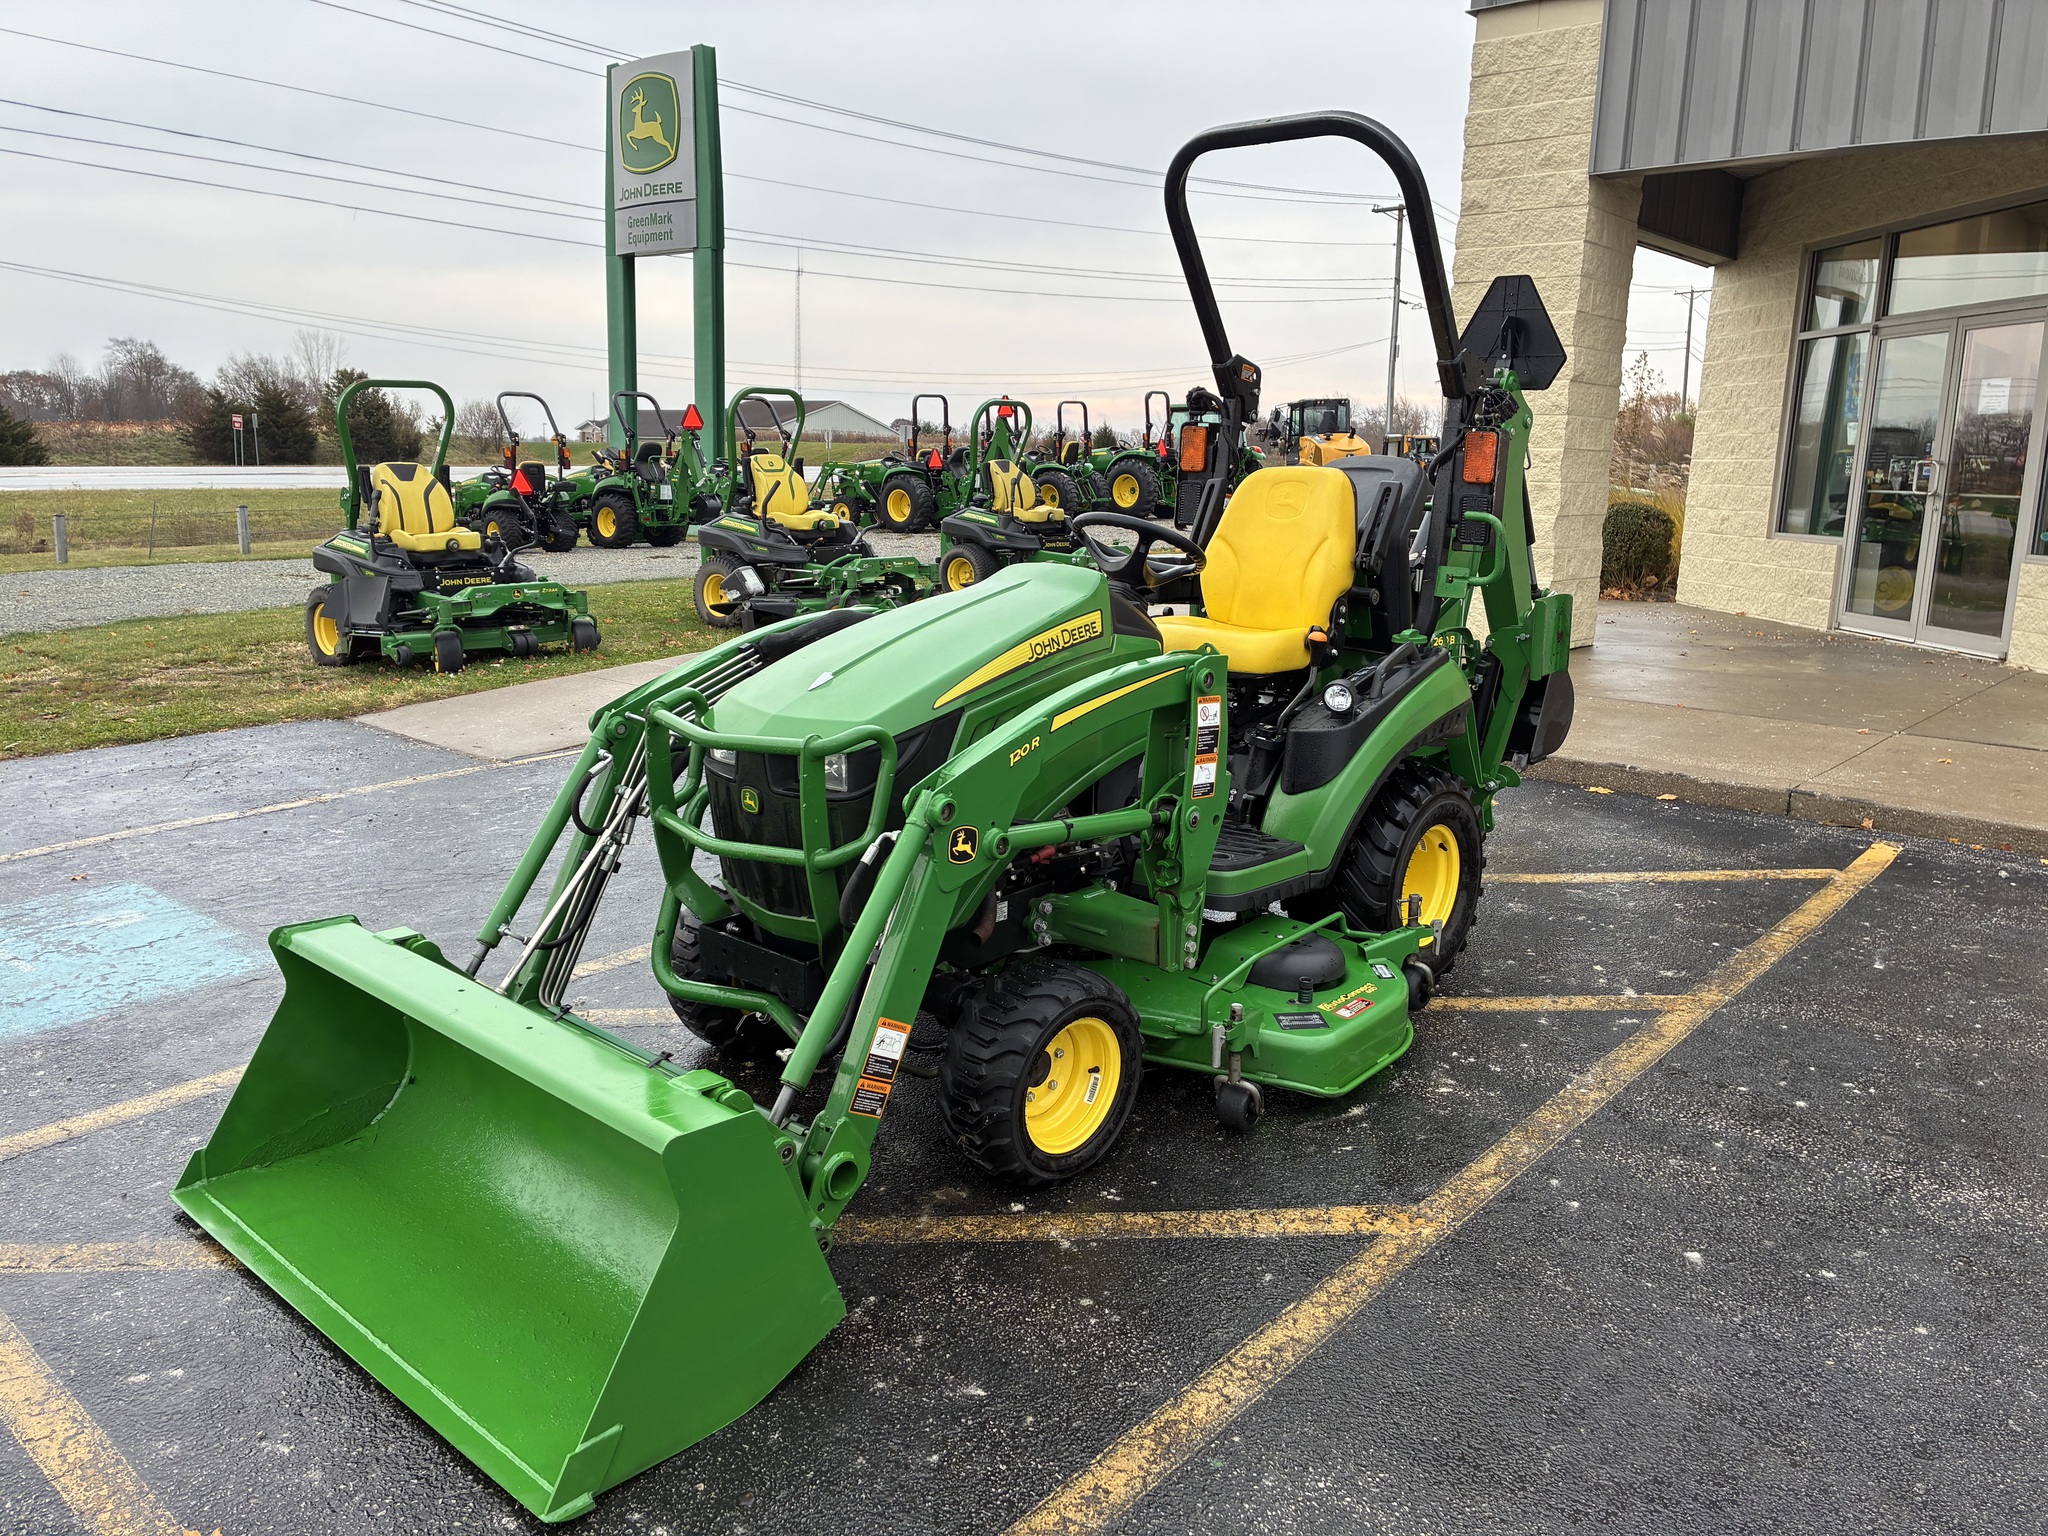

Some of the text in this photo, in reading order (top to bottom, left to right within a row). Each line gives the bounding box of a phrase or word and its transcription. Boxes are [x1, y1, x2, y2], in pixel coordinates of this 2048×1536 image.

[619, 181, 683, 202] JOHN DEERE
[627, 211, 673, 229] GreenMark
[627, 228, 674, 246] Equipment
[440, 577, 492, 586] JOHN DEERE
[1028, 621, 1098, 660] JOHN DEERE
[1009, 736, 1040, 767] 120 R
[1323, 982, 1376, 1010] AutoConnect
[887, 1021, 908, 1032] WARNING
[866, 1083, 887, 1093] WARNING
